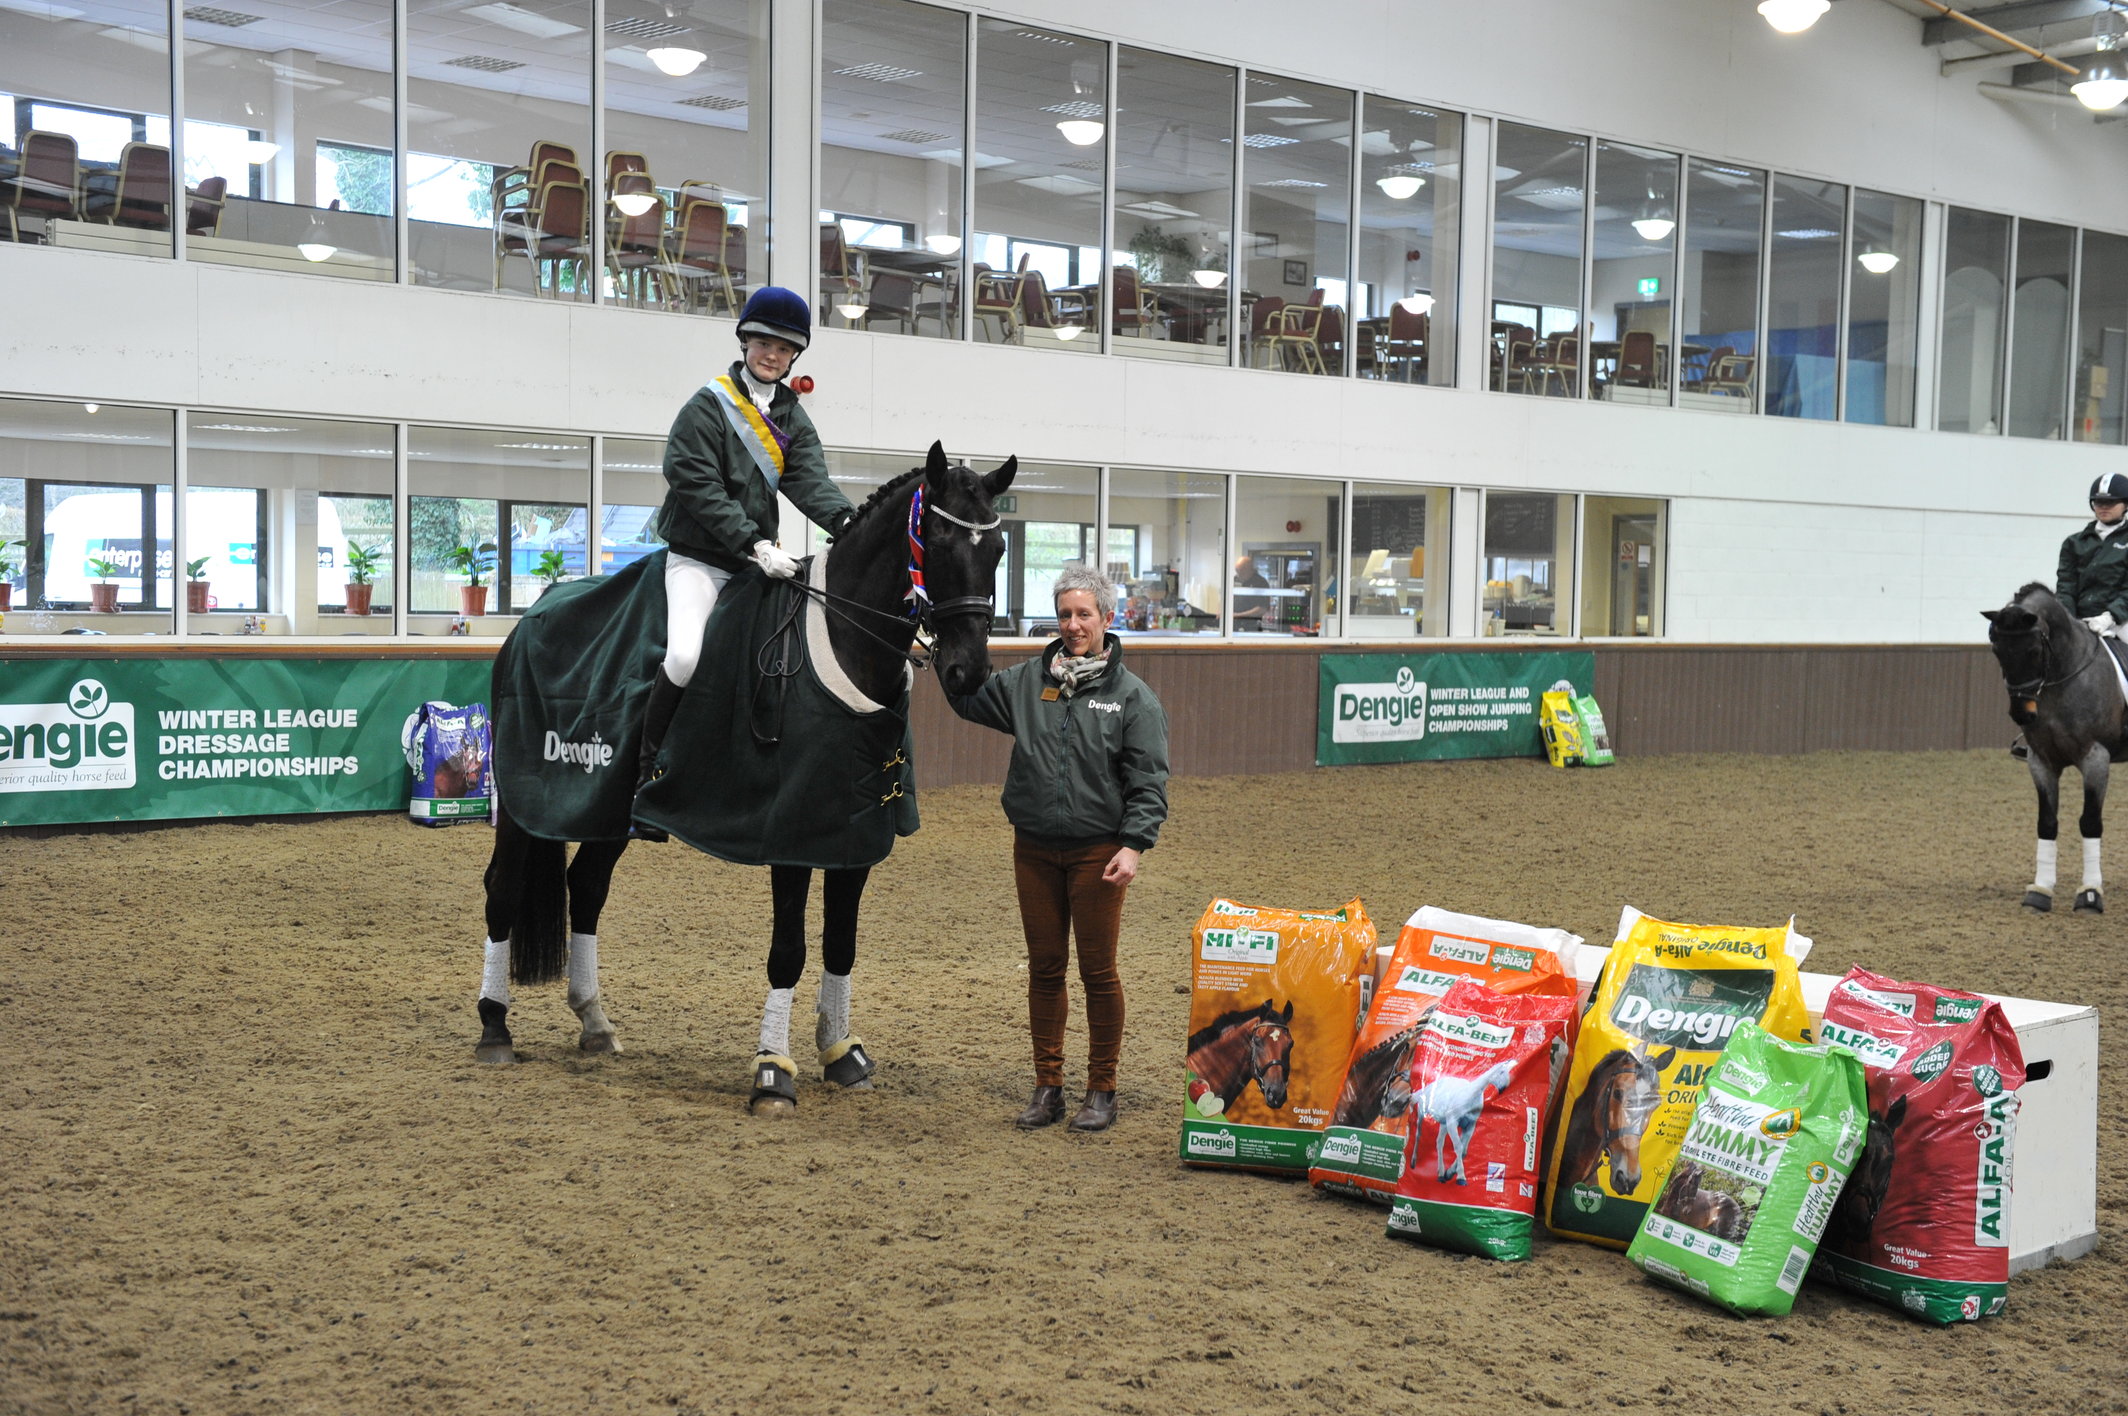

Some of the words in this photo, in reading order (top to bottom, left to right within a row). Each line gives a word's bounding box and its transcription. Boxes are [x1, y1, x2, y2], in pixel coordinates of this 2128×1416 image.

[87, 546, 173, 574] enterpse
[1431, 688, 1468, 700] WINTER
[1471, 687, 1506, 700] LEAGUE
[1509, 687, 1529, 699] AND
[1088, 699, 1121, 713] Dengie
[1340, 694, 1422, 726] Dengie
[1430, 704, 1456, 717] OPEN
[1458, 703, 1488, 716] SHOW
[1490, 702, 1532, 715] JUMPING
[158, 709, 256, 730] WINTER
[264, 709, 358, 729] LEAGUE
[1429, 719, 1508, 732] CHAMPIONSHIPS
[158, 733, 290, 755] DRESSAGE
[543, 730, 613, 774] Dengie
[158, 756, 358, 780] CHAMPIONSHIPS
[28, 770, 68, 786] quality
[72, 770, 101, 782] horse
[104, 768, 127, 783] feed
[1433, 944, 1487, 962] ALFA-A
[1655, 944, 1694, 959] Alfa-A
[1697, 938, 1767, 960] Dengie
[1493, 953, 1532, 970] Dengie
[1404, 971, 1478, 988] ALFA
[1936, 1003, 1980, 1019] Dengie
[1429, 1018, 1508, 1044] ALFA-BEET
[1821, 1025, 1899, 1059] ALFA-A
[1915, 1060, 1949, 1074] SUGAR
[1917, 1051, 1950, 1066] ADDED
[1979, 1069, 1995, 1092] ADDED
[1985, 1074, 2000, 1096] SUGAR
[1667, 1090, 1698, 1105] ORI
[1293, 1106, 1311, 1115] Great
[1312, 1108, 1329, 1116] Value
[1298, 1115, 1323, 1126] 20kgs
[1191, 1135, 1234, 1150] Dengie
[1324, 1140, 1359, 1156] Dengie
[1681, 1144, 1717, 1163] COMLETE
[1717, 1156, 1742, 1171] FIBRE
[1743, 1166, 1768, 1181] FEED
[1981, 1097, 2010, 1240] ALFA-A
[1796, 1185, 1824, 1234] Healthy
[1807, 1172, 1842, 1237] TUMMY
[1884, 1243, 1904, 1254] Great
[1905, 1248, 1927, 1258] Value
[1890, 1254, 1919, 1270] 20kgs
